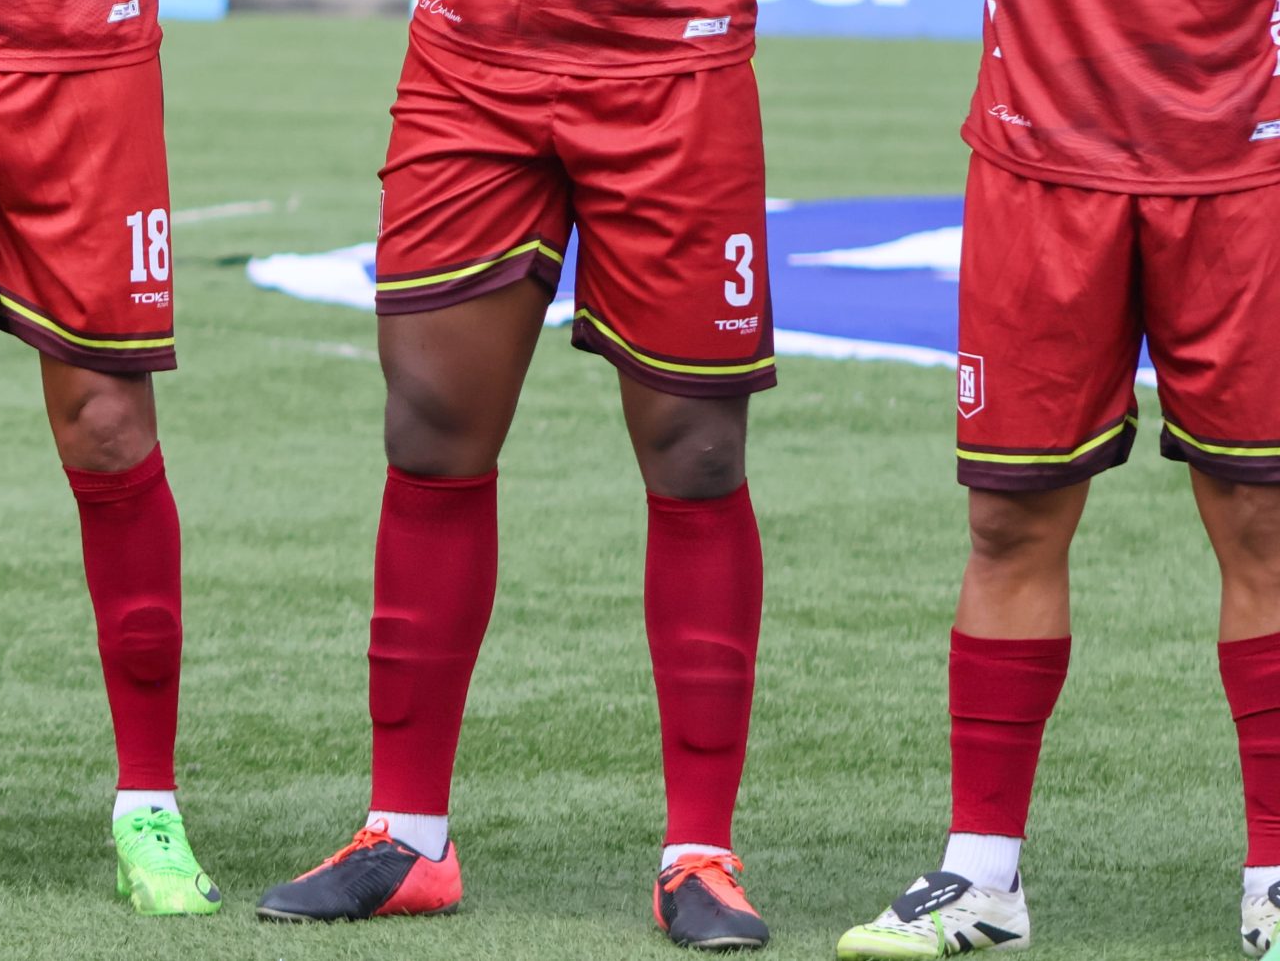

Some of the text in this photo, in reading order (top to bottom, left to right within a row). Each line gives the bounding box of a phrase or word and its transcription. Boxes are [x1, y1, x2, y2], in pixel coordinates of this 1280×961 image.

[126, 207, 170, 283] 18
[724, 232, 754, 307] 3
[131, 291, 169, 304] TOKE
[714, 316, 758, 331] TOKE
